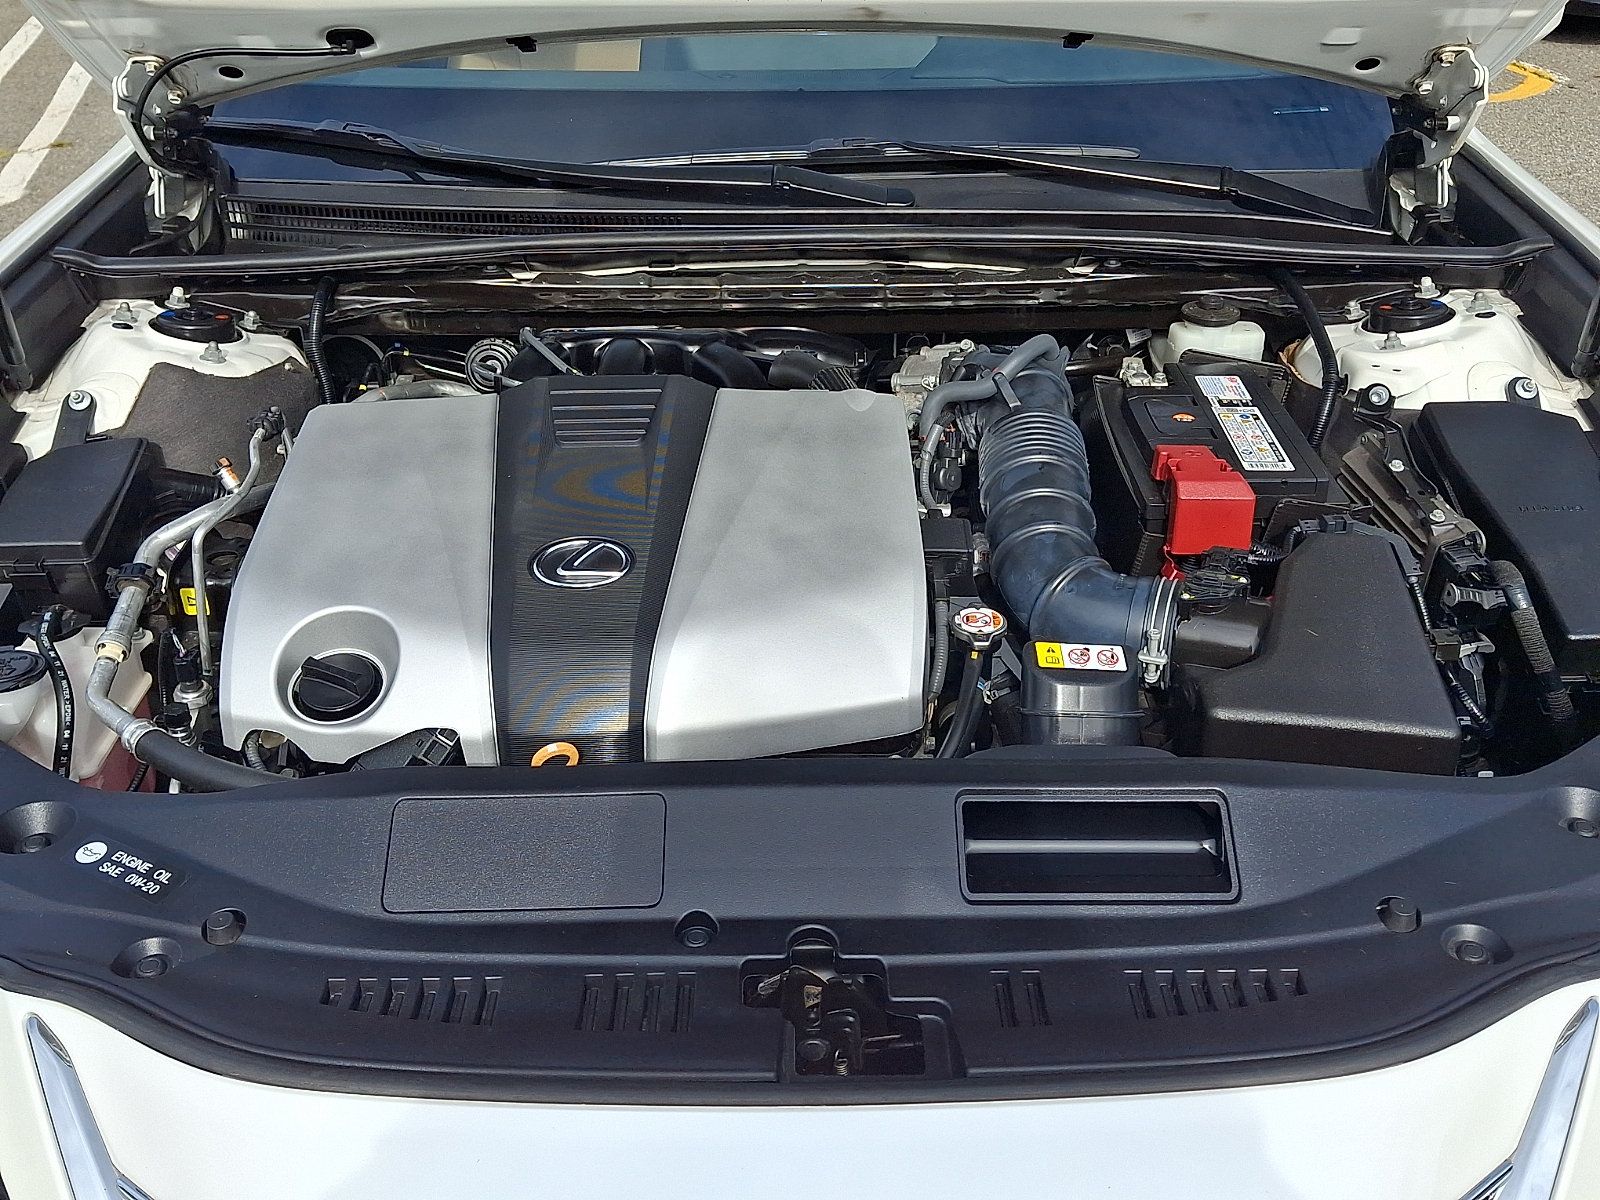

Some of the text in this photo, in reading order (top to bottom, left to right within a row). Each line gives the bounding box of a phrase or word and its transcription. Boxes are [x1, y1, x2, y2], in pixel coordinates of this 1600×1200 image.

[61, 680, 70, 700] WATER
[98, 861, 125, 878] SAE
[111, 850, 173, 885] ENGINE OIL
